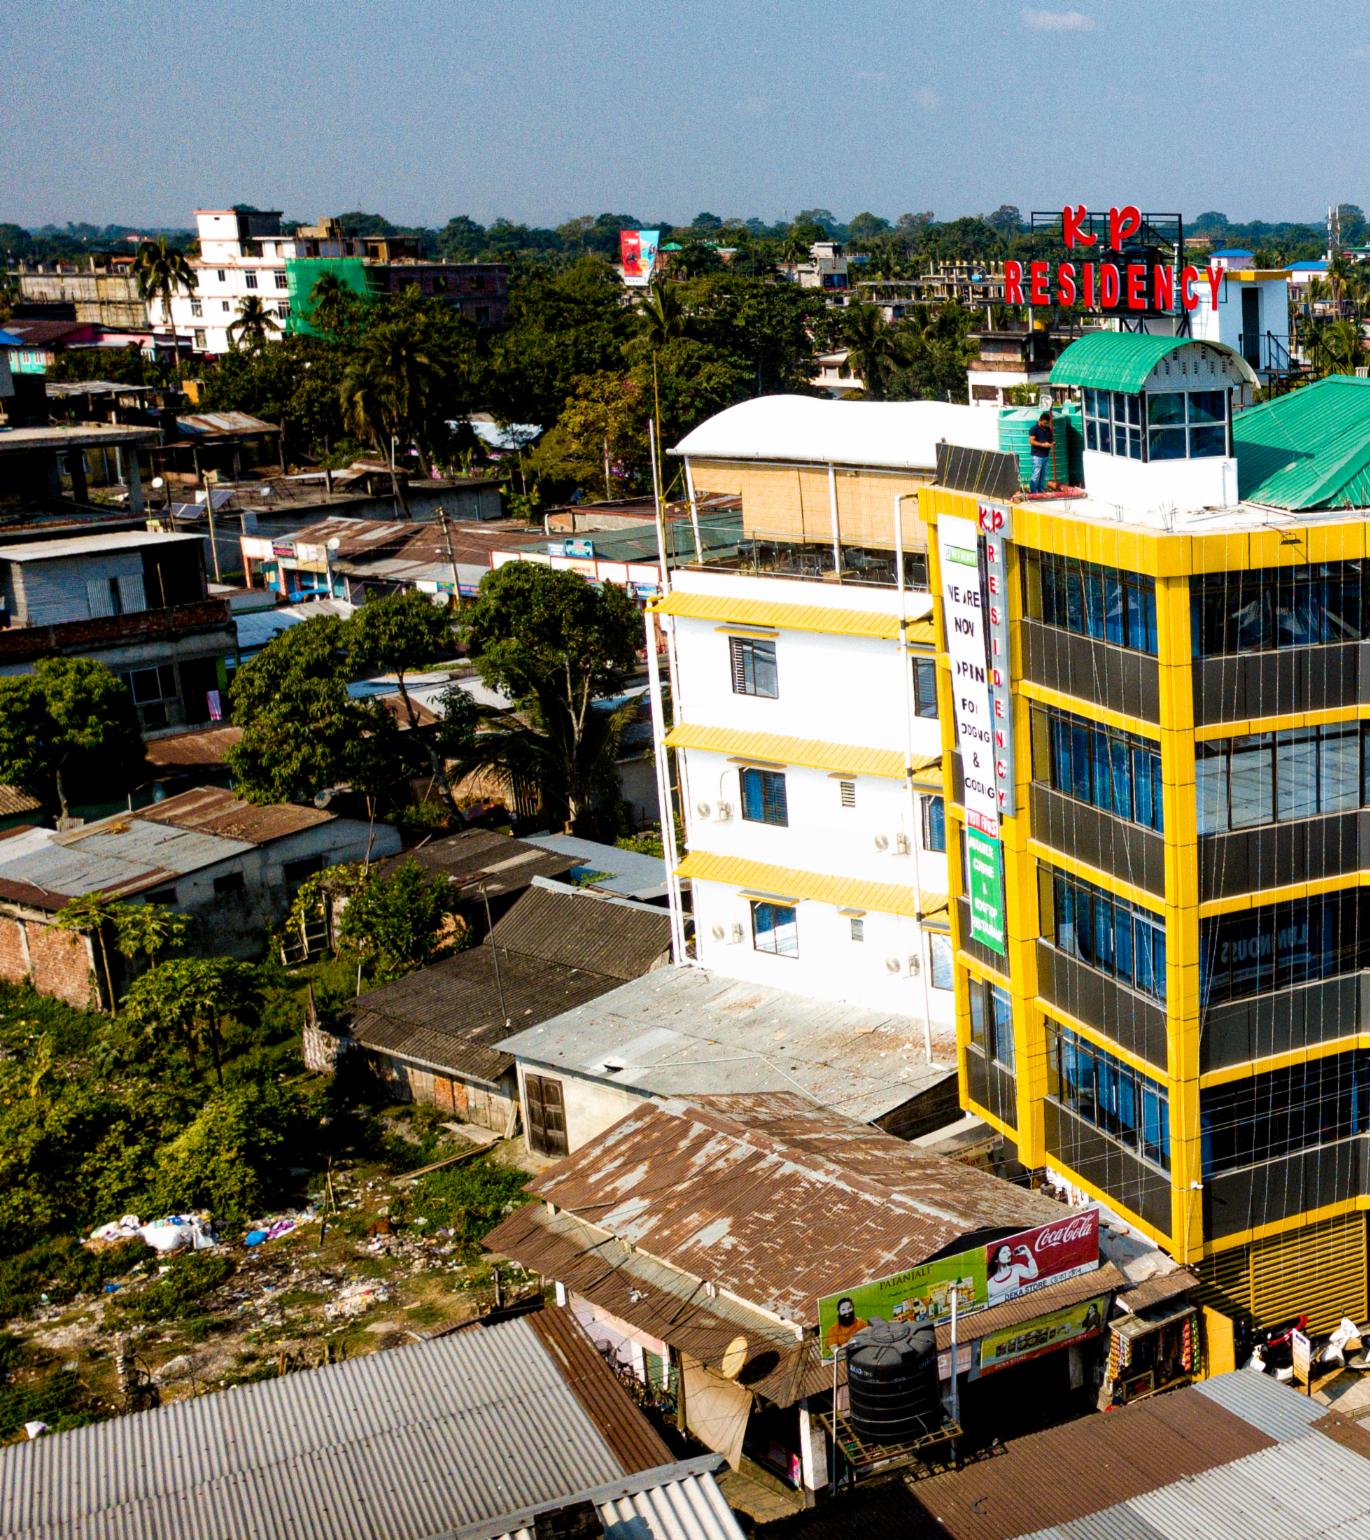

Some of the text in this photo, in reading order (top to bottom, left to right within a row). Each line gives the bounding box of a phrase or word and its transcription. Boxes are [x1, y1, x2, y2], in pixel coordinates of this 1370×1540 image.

[1004, 260, 1224, 311] RESIDENCY
[987, 544, 1006, 807] RESIDENCY
[1035, 1213, 1096, 1252] Coca-Cola
[880, 1265, 930, 1290] PATANJALI
[1004, 1280, 1047, 1300] DEKA STORE
